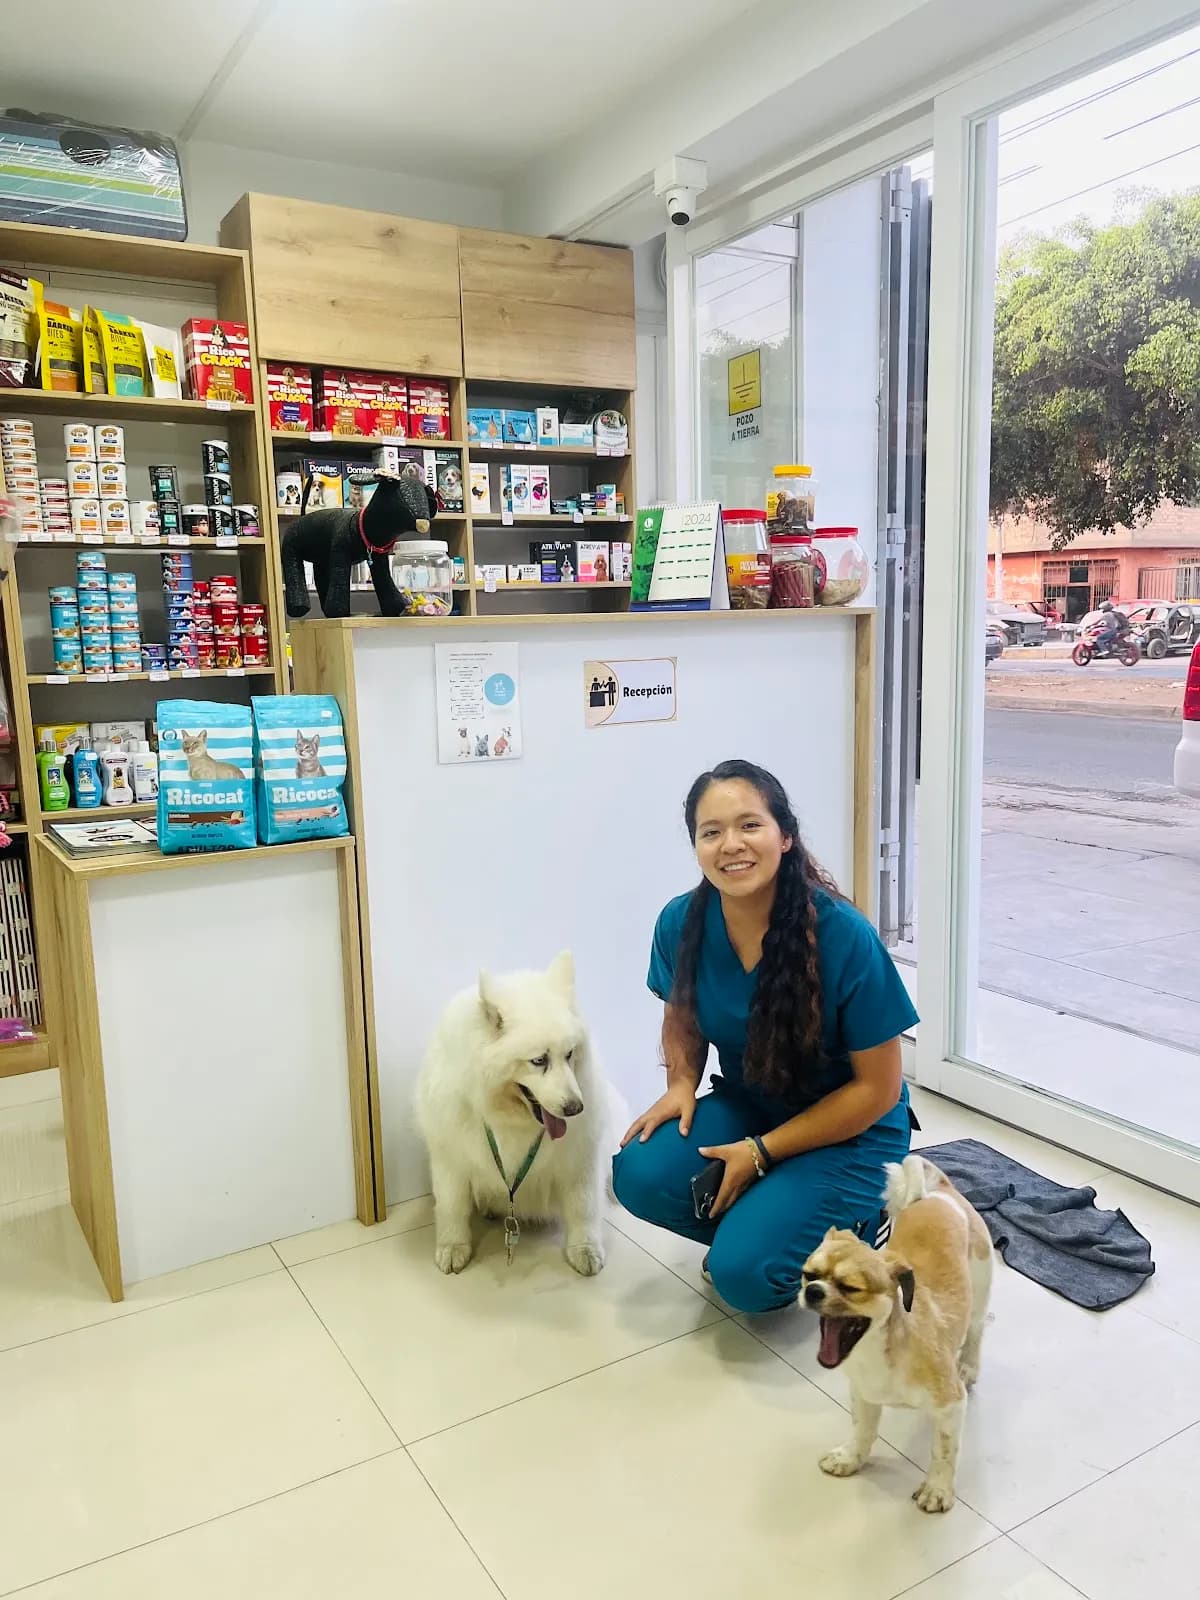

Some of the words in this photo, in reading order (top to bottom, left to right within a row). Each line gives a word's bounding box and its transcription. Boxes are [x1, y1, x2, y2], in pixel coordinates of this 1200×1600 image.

[209, 345, 236, 356] Rico
[200, 353, 245, 368] CRACK
[280, 384, 301, 394] Rico
[335, 390, 355, 399] Rico
[272, 391, 308, 403] CRACK
[328, 397, 362, 408] CRACK
[376, 393, 397, 402] Rico
[370, 400, 403, 411] CRACK
[414, 405, 446, 416] CRACK
[736, 413, 754, 427] POZO
[731, 432, 736, 441] A
[737, 425, 760, 440] TIERRA
[684, 513, 711, 525] 2024
[623, 684, 672, 698] Recepción
[166, 787, 243, 806] Ricocat
[271, 786, 339, 804] Ricoca
